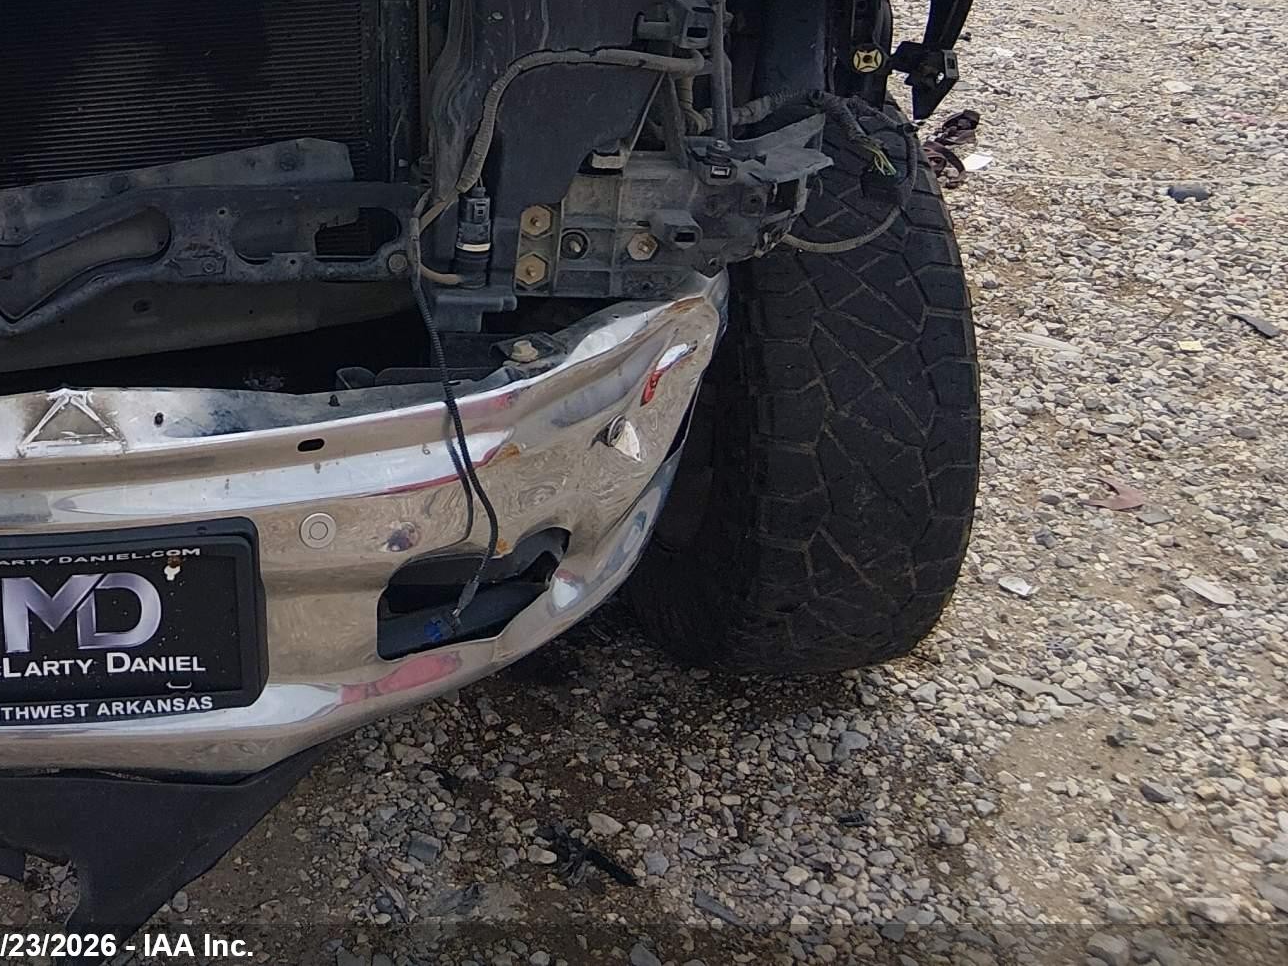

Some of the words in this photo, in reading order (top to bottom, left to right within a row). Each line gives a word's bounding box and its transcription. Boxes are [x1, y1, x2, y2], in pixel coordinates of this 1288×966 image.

[1, 572, 161, 653] MD
[106, 651, 206, 673] DANIEL
[97, 696, 213, 716] ARKANSAS
